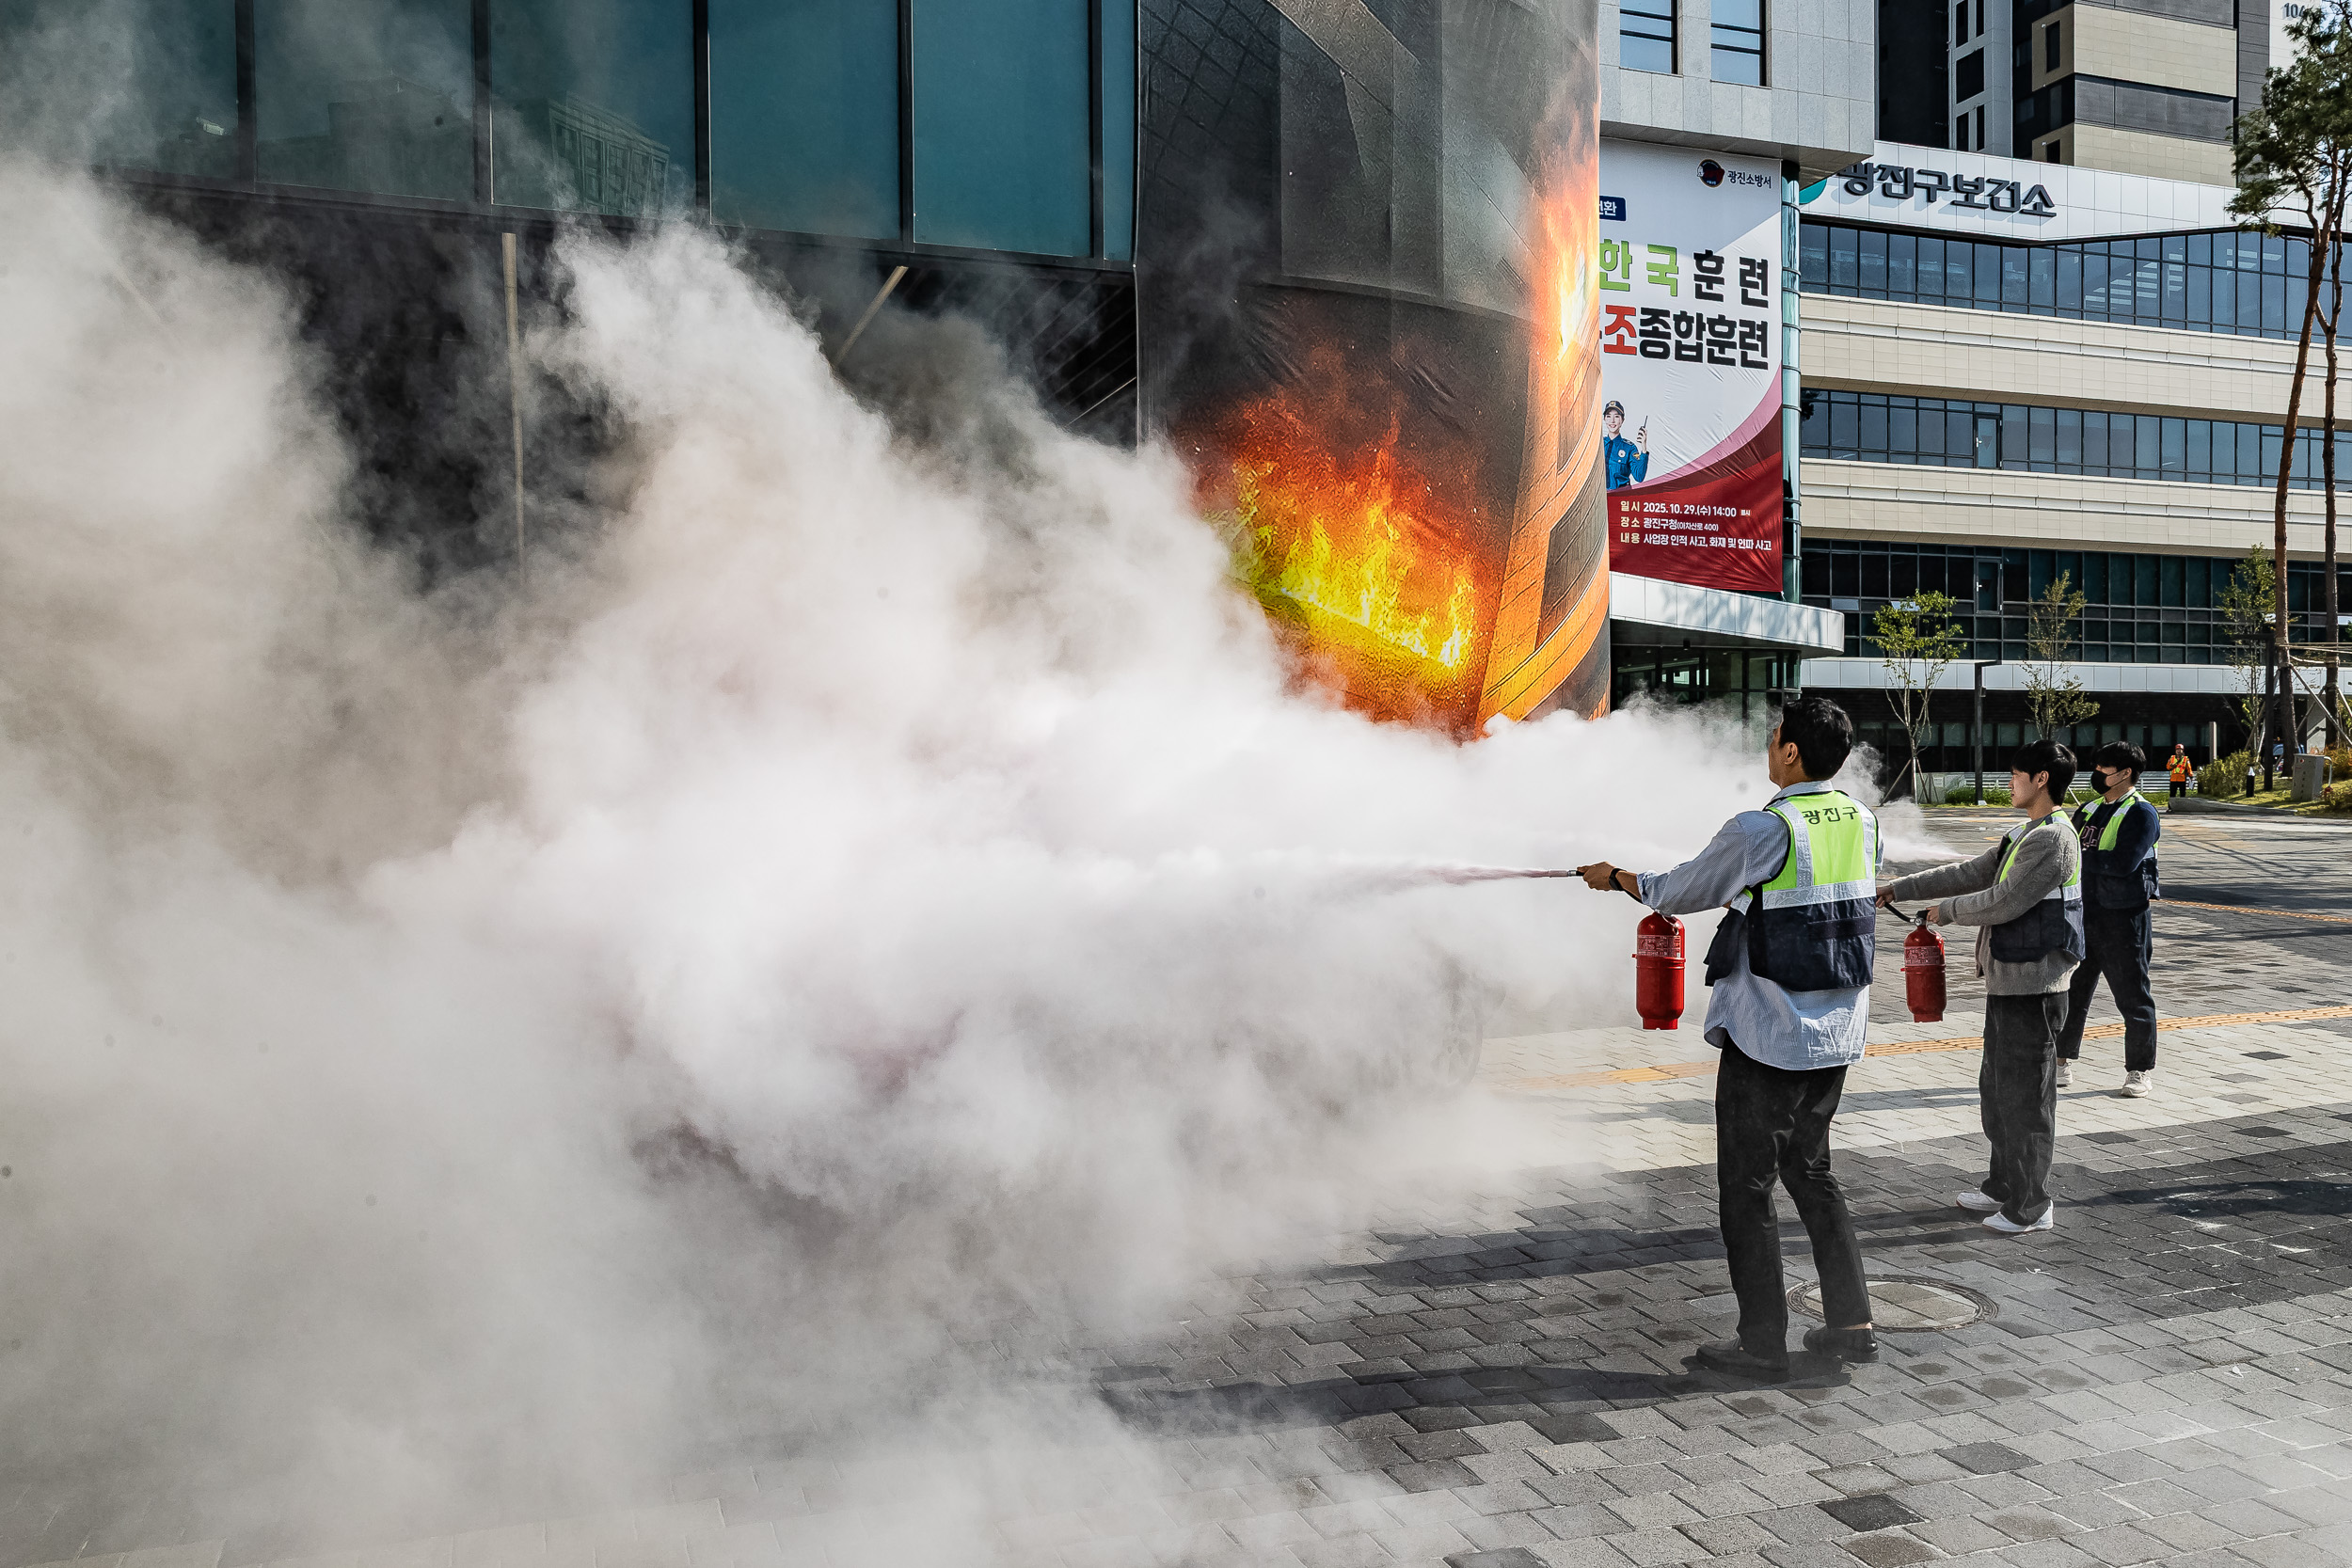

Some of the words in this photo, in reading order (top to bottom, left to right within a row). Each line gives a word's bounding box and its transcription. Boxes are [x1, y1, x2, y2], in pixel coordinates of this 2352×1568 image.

[1727, 170, 1772, 189] 광진소방서
[1836, 162, 2057, 217] 광진구보건소
[1599, 304, 1769, 371] 조종합훈련
[1644, 502, 1668, 514] 2025.
[1670, 503, 1682, 514] 10.
[1712, 506, 1737, 517] 14:00
[1644, 533, 1669, 546] 사업장
[1670, 534, 1688, 546] 인적
[1689, 536, 1708, 547] 사고,
[1709, 536, 1726, 548] 화재
[1727, 537, 1737, 548] 및
[1755, 539, 1772, 551] 사고
[1802, 806, 1859, 825] 광진구
